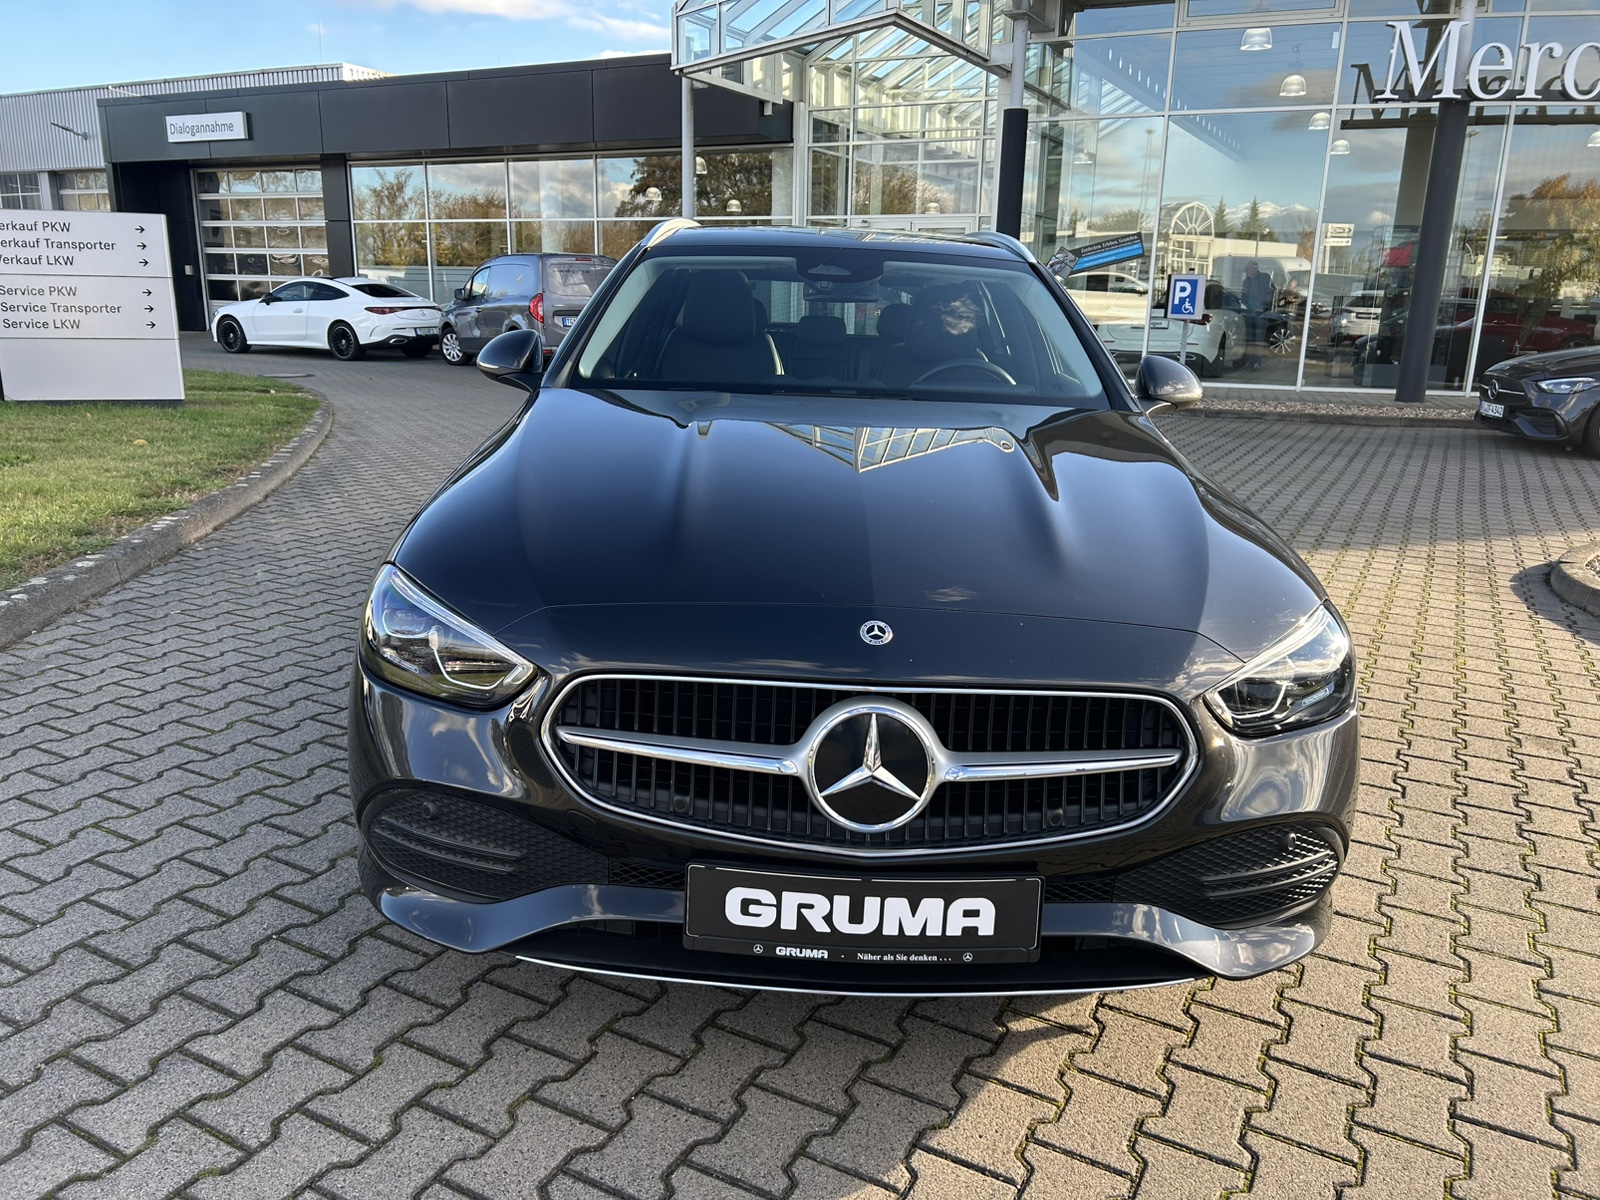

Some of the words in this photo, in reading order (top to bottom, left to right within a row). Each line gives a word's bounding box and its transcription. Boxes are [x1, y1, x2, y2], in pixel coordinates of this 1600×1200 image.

[1374, 20, 1600, 100] Merc
[169, 120, 234, 137] Dialogannahme
[0, 220, 38, 231] erkauf
[42, 221, 71, 233] PKW
[0, 237, 40, 248] erkauf
[43, 238, 116, 252] Transporter
[0, 254, 42, 265] erkauf
[47, 255, 74, 266] LKW
[0, 284, 45, 296] Service
[48, 285, 77, 297] PKW
[1173, 281, 1192, 304] P
[0, 301, 47, 312] Service
[50, 302, 122, 316] Transporter
[2, 318, 49, 329] Service
[53, 319, 81, 330] LKW
[725, 886, 996, 937] GRUMA
[775, 946, 829, 959] GRUMA
[857, 952, 881, 961] Näher
[883, 953, 894, 961] als
[895, 953, 908, 961] Sie
[909, 953, 938, 961] denken
